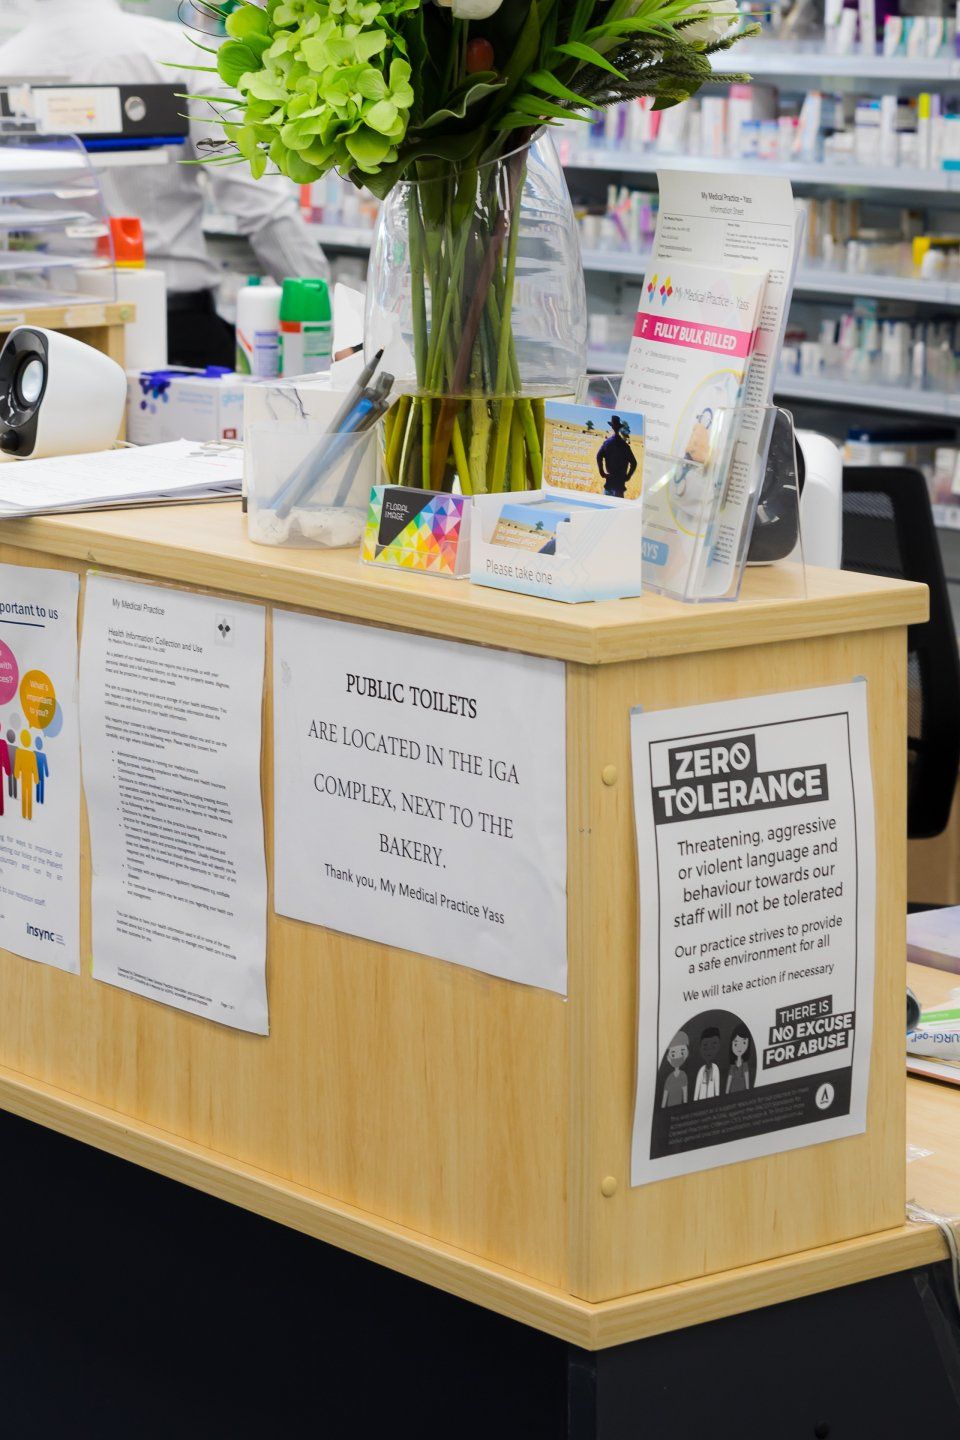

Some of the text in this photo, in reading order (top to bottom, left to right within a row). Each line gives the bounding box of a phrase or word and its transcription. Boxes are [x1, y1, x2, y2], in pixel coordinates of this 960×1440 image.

[708, 192, 723, 202] Medical
[724, 194, 740, 203] Practice
[675, 287, 683, 301] My
[685, 288, 706, 303] Medical
[707, 291, 729, 307] Practice
[736, 296, 750, 311] Yass
[654, 322, 738, 351] FULLY BULK BILLED
[385, 511, 404, 521] IMAGE
[386, 502, 410, 513] FLORAL
[641, 538, 659, 559] AYS
[486, 559, 553, 585] Please take one
[36, 606, 46, 618] to
[49, 609, 59, 620] us
[112, 598, 165, 616] My Medical Practice
[108, 628, 125, 639] Health
[155, 636, 181, 650] Collection
[182, 642, 191, 651] and
[193, 645, 203, 654] Use
[346, 673, 477, 719] PUBLIC TOILETS
[308, 720, 520, 785] ARE LOCATED IN THE IGA
[675, 742, 751, 780] ZERO
[314, 772, 514, 840] COMPLEX, NEXT TO THE
[658, 768, 822, 817] TOLERANCE
[379, 833, 446, 869] BAKERY.
[677, 816, 837, 857] Threatening, aggressive
[678, 838, 838, 880] or violent language and
[324, 863, 505, 925] Thank you, My Medical Practice Yass
[683, 864, 835, 903] behaviour towards our
[674, 881, 844, 928] staff will not be tolerated
[674, 915, 843, 958] Our practice strives to provide
[688, 934, 830, 974] a safe environment for all
[683, 962, 835, 1002] We will take action if necessary
[772, 1013, 853, 1042] NO EXCUSE
[779, 1000, 830, 1024] THERE IS
[765, 1032, 846, 1065] FOR ABUSE
[914, 1032, 960, 1044] URGI-gel
